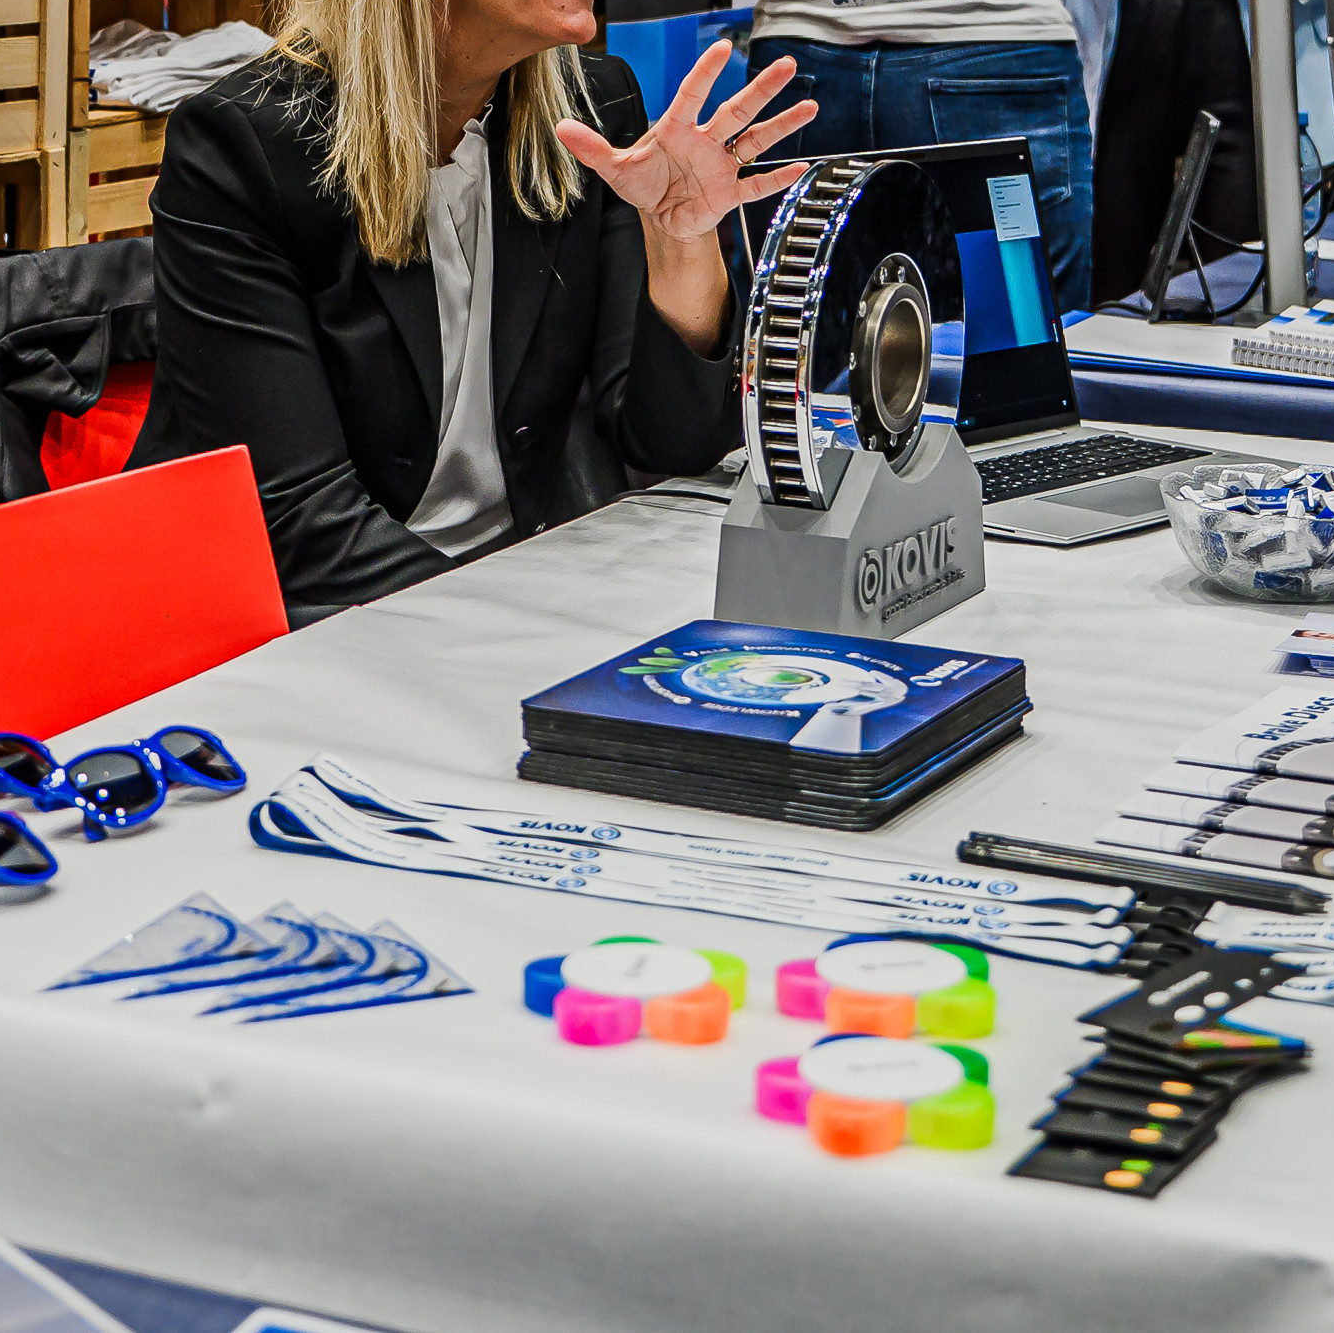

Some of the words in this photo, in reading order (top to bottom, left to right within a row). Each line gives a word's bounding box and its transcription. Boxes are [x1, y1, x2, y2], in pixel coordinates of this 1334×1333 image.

[1242, 719, 1309, 741] Brake
[519, 819, 587, 834] KOVIS
[497, 839, 565, 853] KOVIS
[497, 854, 566, 869] KOVIS
[907, 872, 983, 890] KOVIS
